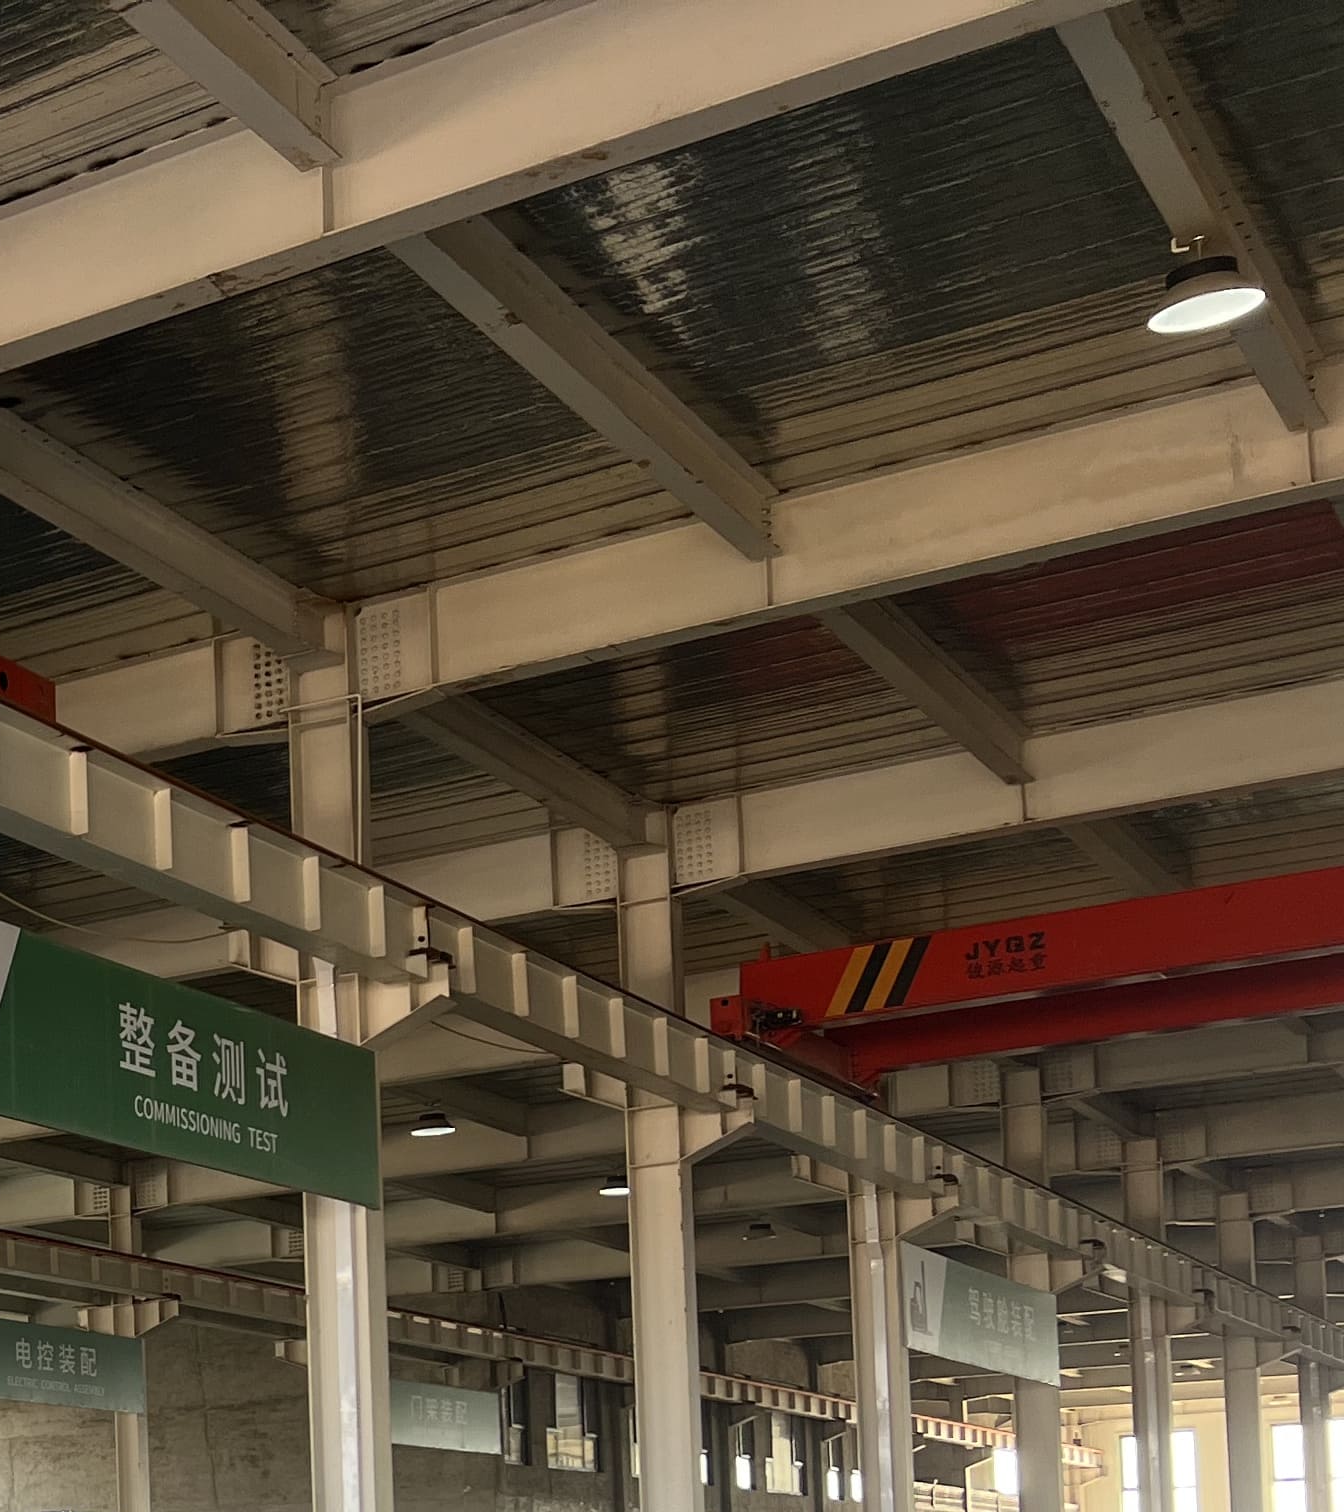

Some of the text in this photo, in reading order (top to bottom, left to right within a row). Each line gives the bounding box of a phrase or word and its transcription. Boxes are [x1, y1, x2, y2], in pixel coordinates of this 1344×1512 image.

[118, 1002, 288, 1117] 整备测试
[134, 1095, 278, 1153] COMMISSIONING TEST
[15, 1337, 98, 1377] 电控装配
